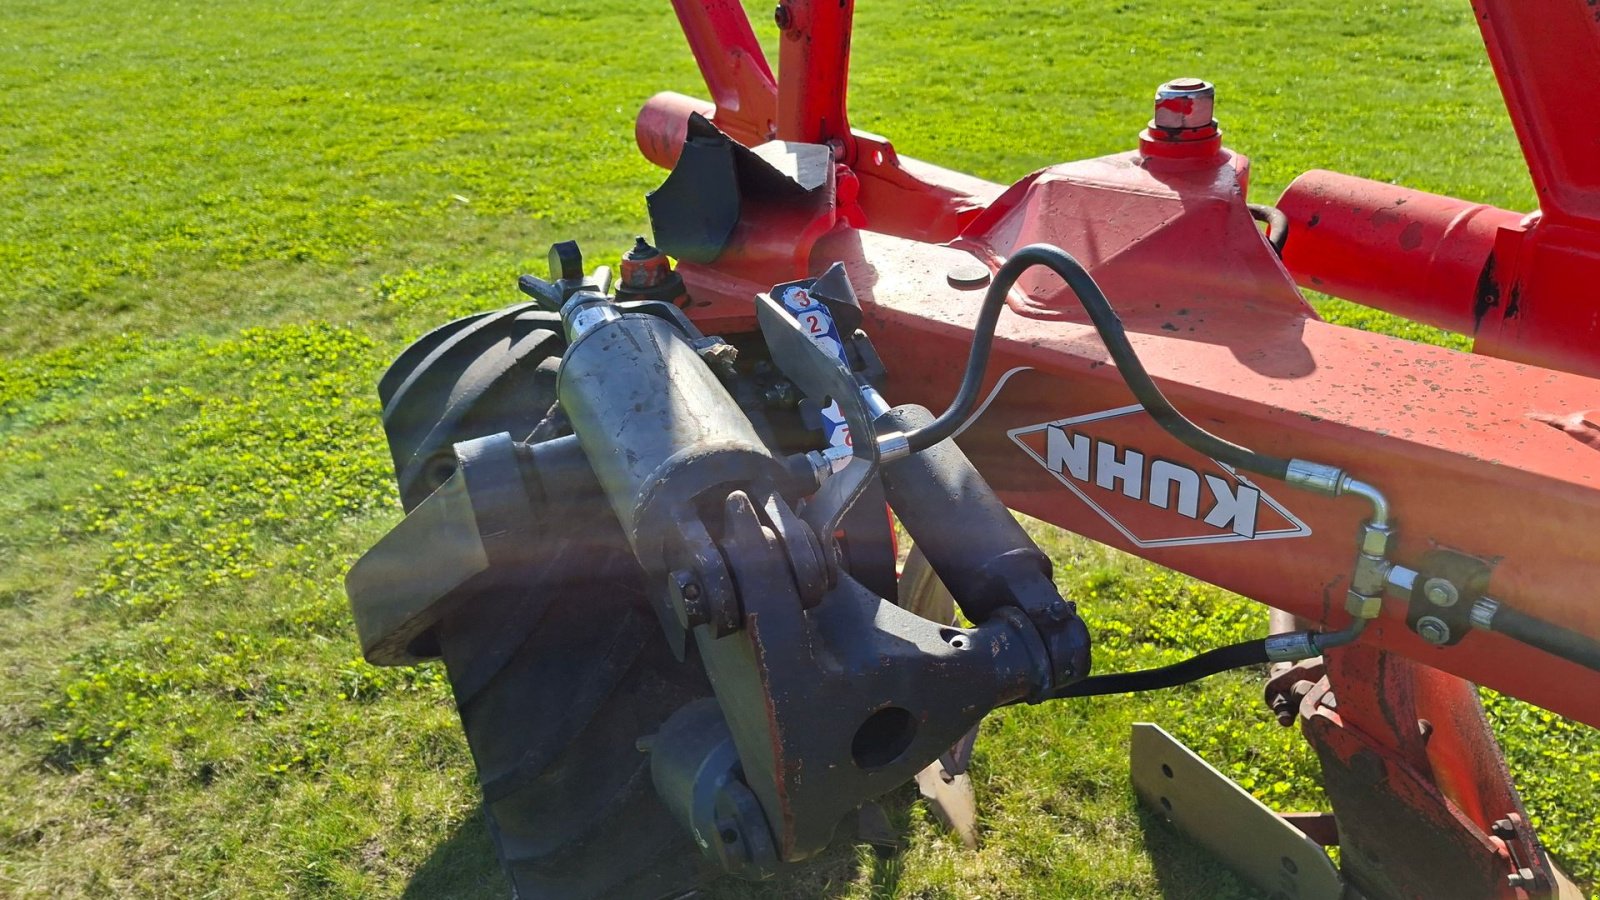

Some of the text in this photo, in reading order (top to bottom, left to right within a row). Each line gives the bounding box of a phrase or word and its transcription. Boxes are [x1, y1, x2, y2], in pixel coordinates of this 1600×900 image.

[795, 290, 811, 308] 3
[806, 315, 822, 333] 2
[1047, 424, 1260, 539] KUHN
